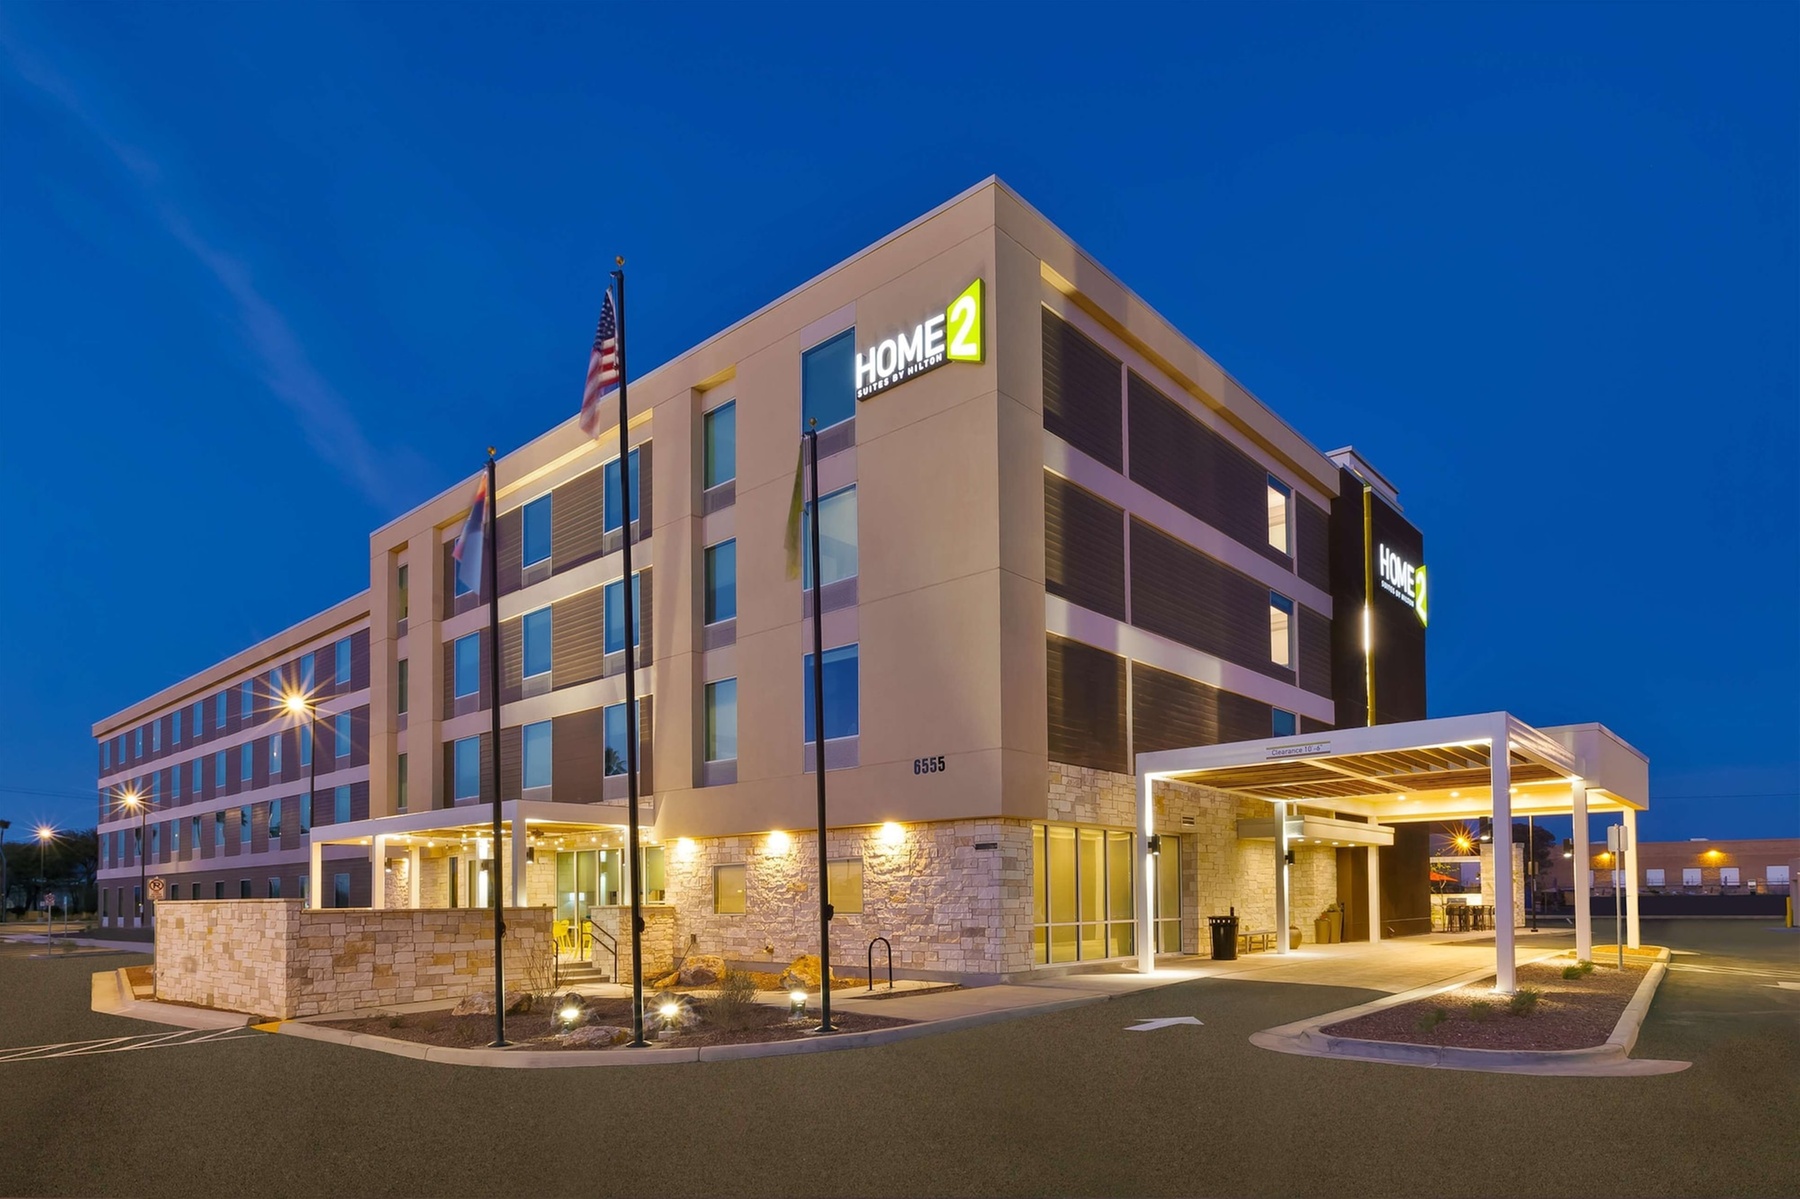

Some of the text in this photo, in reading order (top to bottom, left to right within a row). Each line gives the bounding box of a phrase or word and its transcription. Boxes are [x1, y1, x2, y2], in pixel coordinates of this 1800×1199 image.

[856, 295, 977, 389] HOME 2
[857, 352, 942, 398] SUITES BY HILTON
[1380, 543, 1415, 598] HOME
[1416, 571, 1427, 625] 2
[913, 756, 946, 775] 6555
[1271, 748, 1303, 756] Clearance
